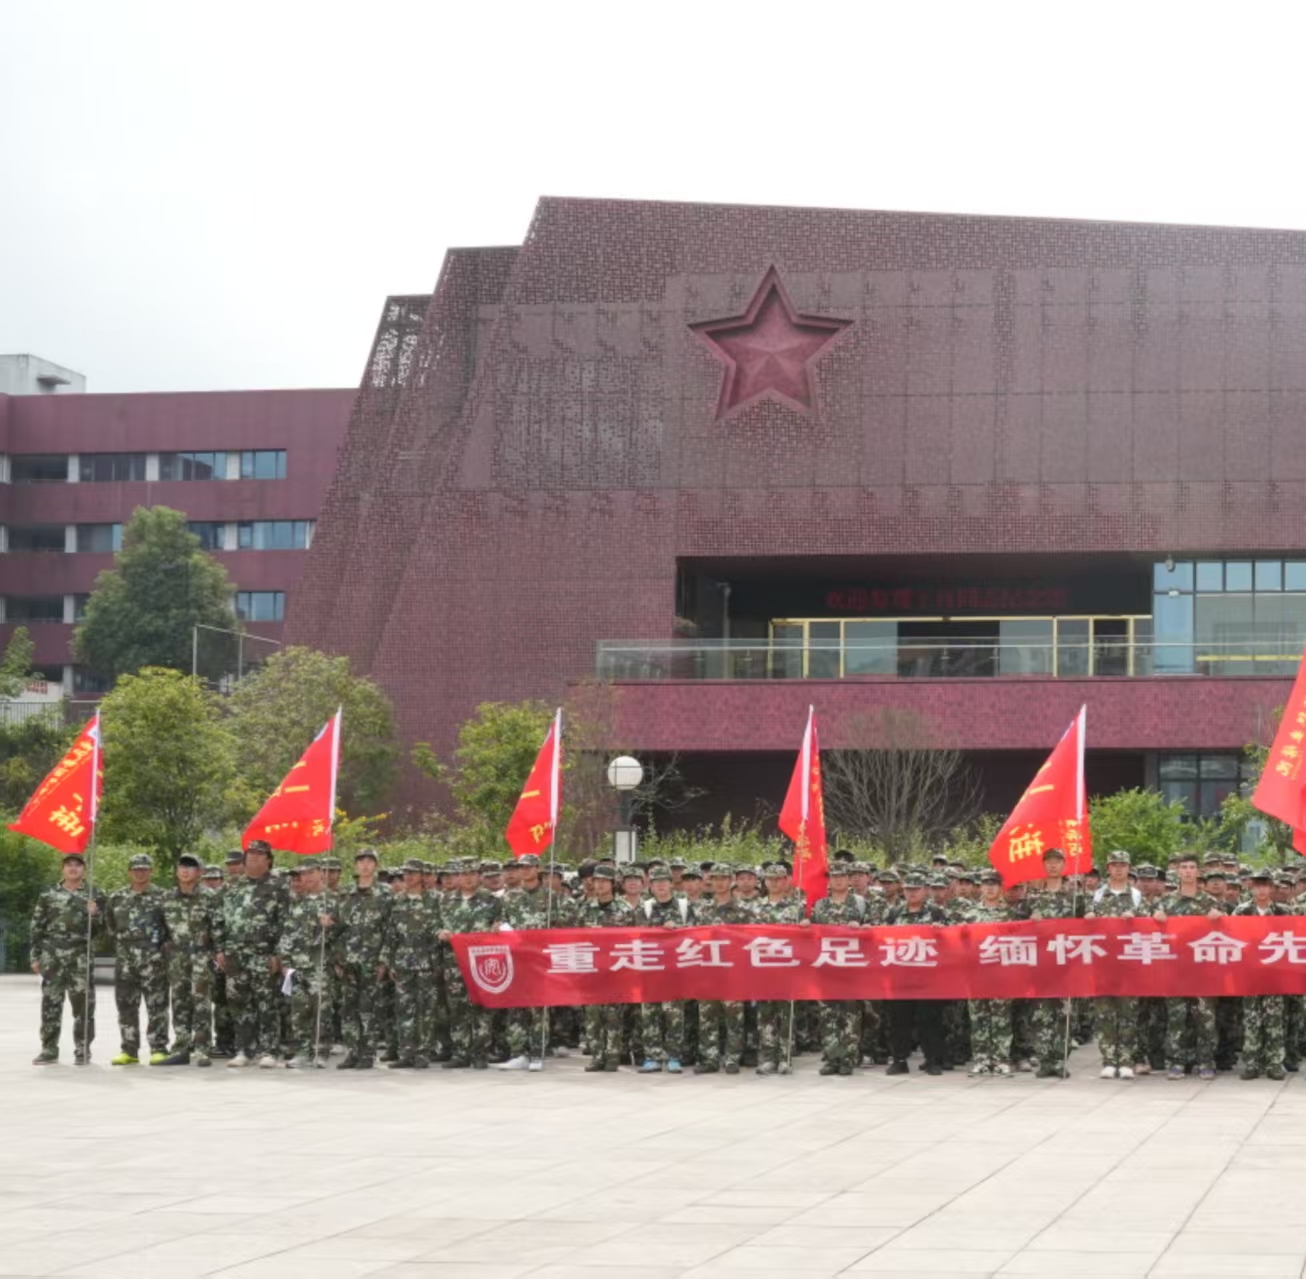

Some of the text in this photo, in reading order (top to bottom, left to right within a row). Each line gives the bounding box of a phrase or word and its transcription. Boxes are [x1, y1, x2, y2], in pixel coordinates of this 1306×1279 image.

[542, 936, 938, 973] 重走红色足迹
